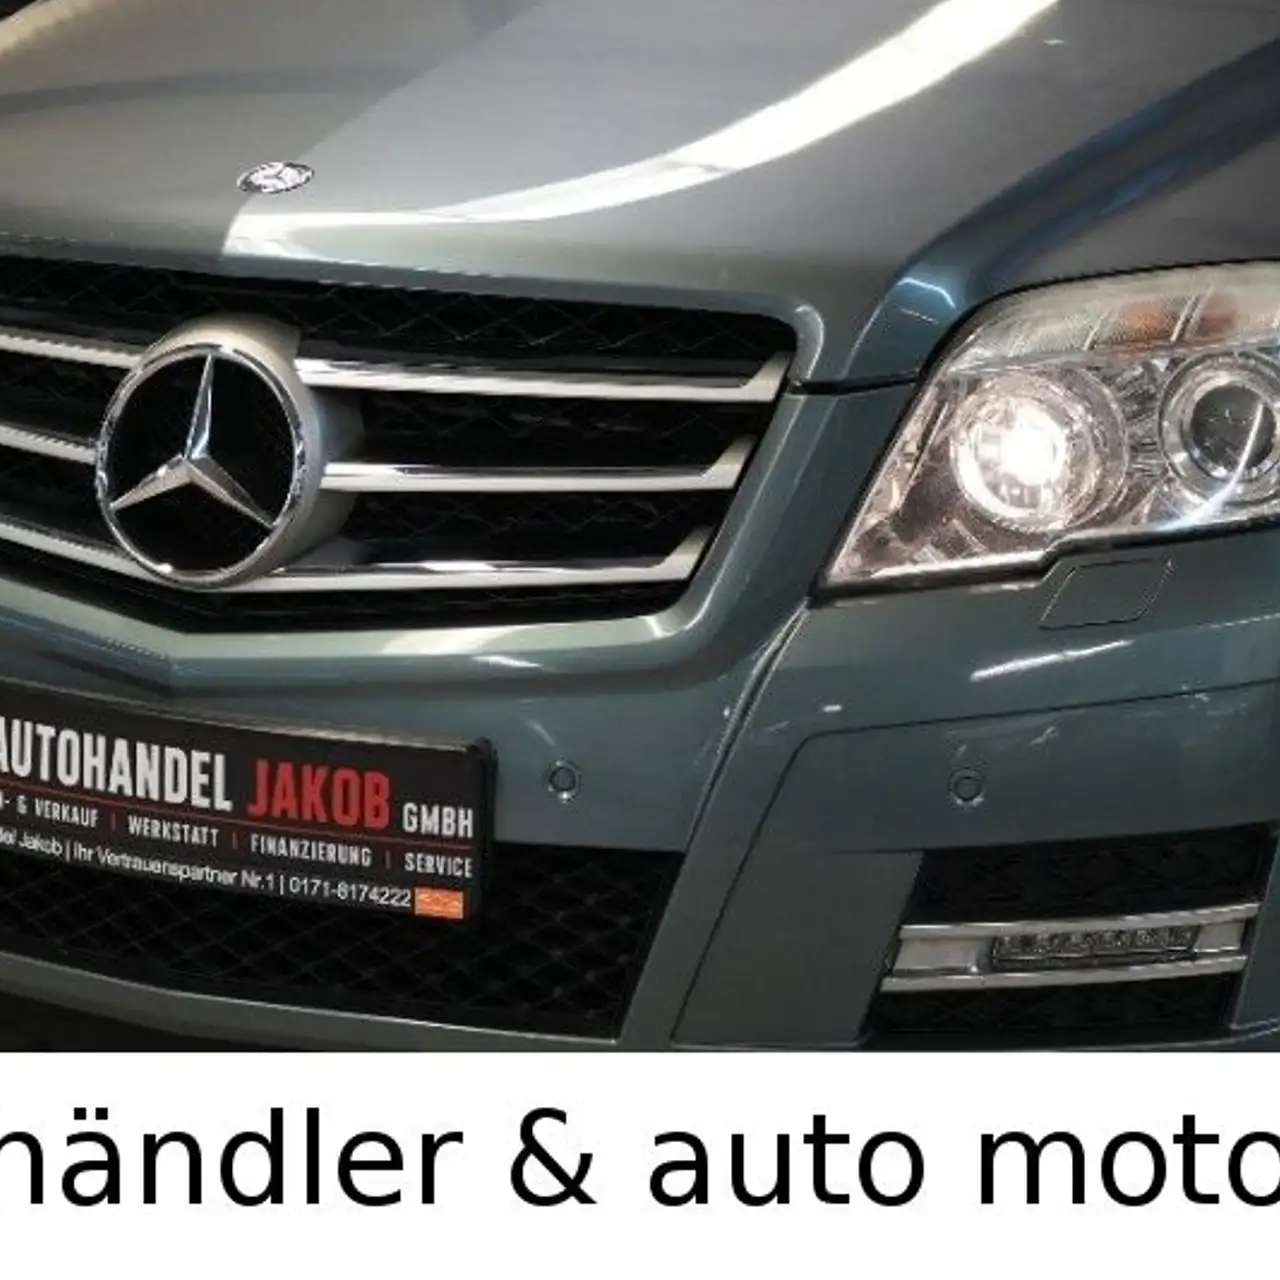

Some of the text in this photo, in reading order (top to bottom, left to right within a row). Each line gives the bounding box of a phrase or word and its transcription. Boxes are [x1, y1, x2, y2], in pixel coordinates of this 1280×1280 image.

[34, 797, 99, 829] VERKAUF
[128, 814, 219, 848] WERKSTATT
[250, 832, 373, 868] FINANZIERUNG
[404, 852, 474, 879] SERVICE
[247, 759, 390, 831] JAKOB
[402, 802, 474, 839] GMBH
[18, 830, 63, 856] Jakob
[73, 841, 96, 863] Ihr
[96, 844, 239, 886] Vertrauenspartner
